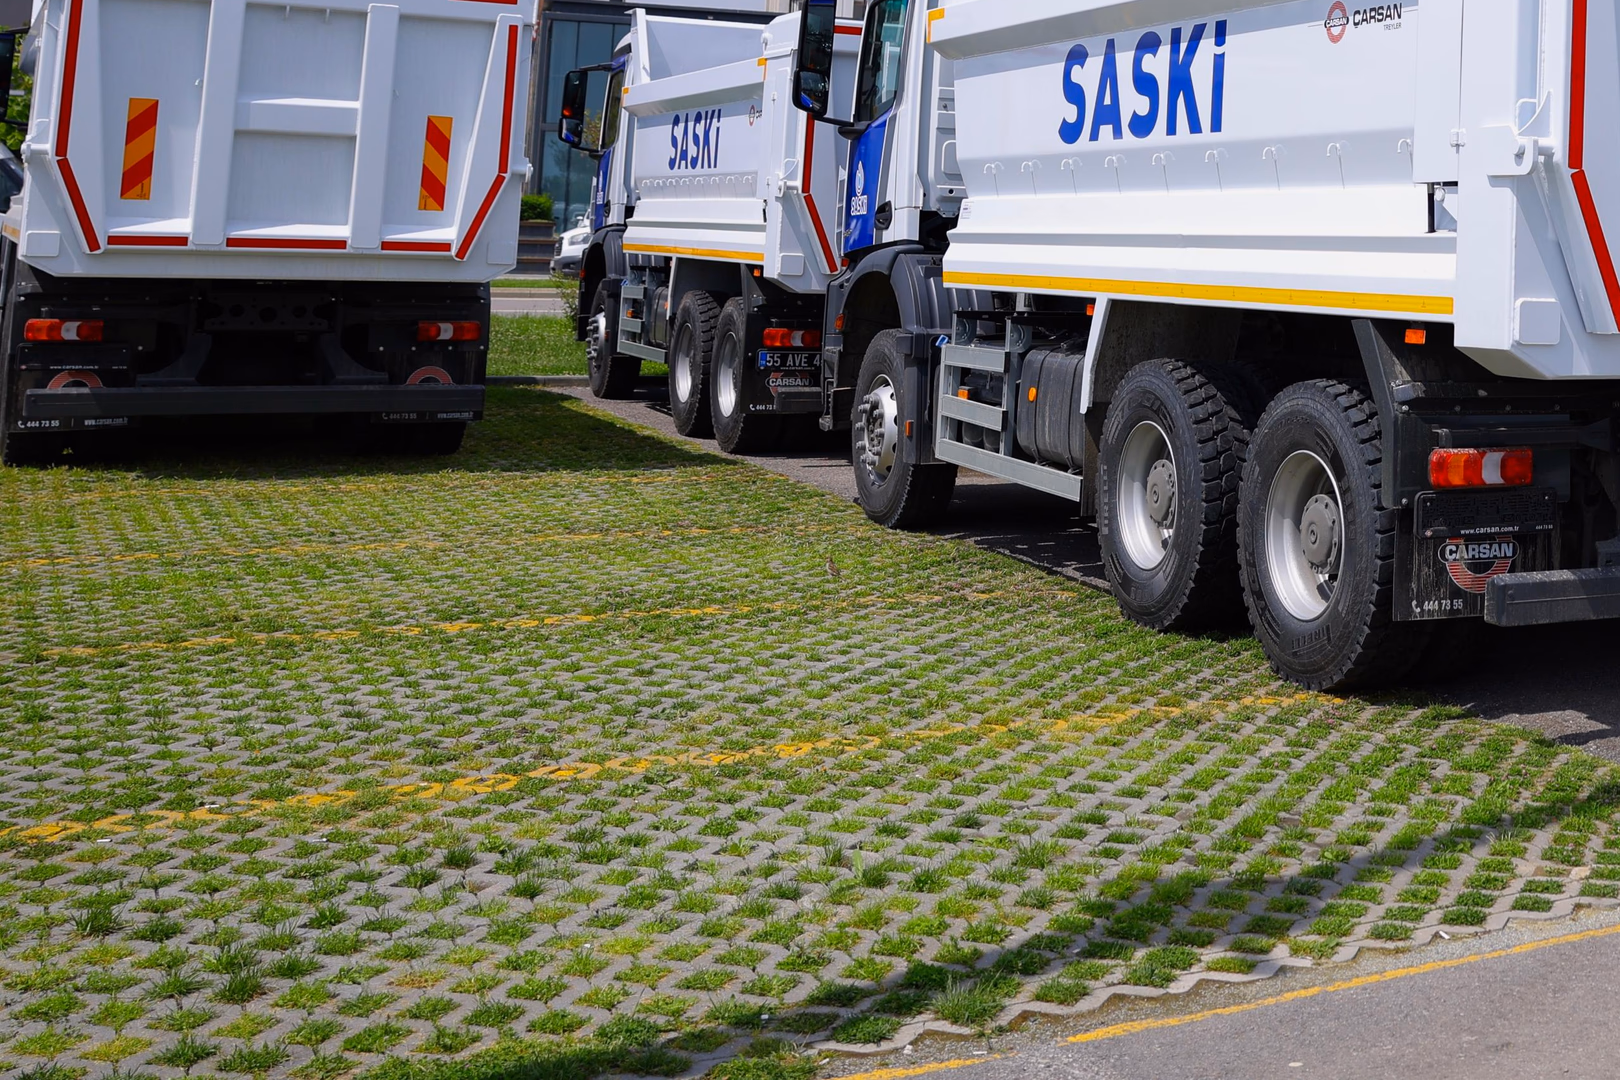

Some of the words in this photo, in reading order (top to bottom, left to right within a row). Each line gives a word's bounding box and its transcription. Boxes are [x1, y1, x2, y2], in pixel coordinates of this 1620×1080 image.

[1383, 22, 1402, 31] TREYLER
[766, 354, 781, 366] 55
[786, 354, 809, 367] AVE
[1460, 525, 1520, 535] www.carsan.com.tr
[1423, 600, 1438, 611] 444
[1441, 599, 1451, 610] 73
[1453, 599, 1463, 610] 55
